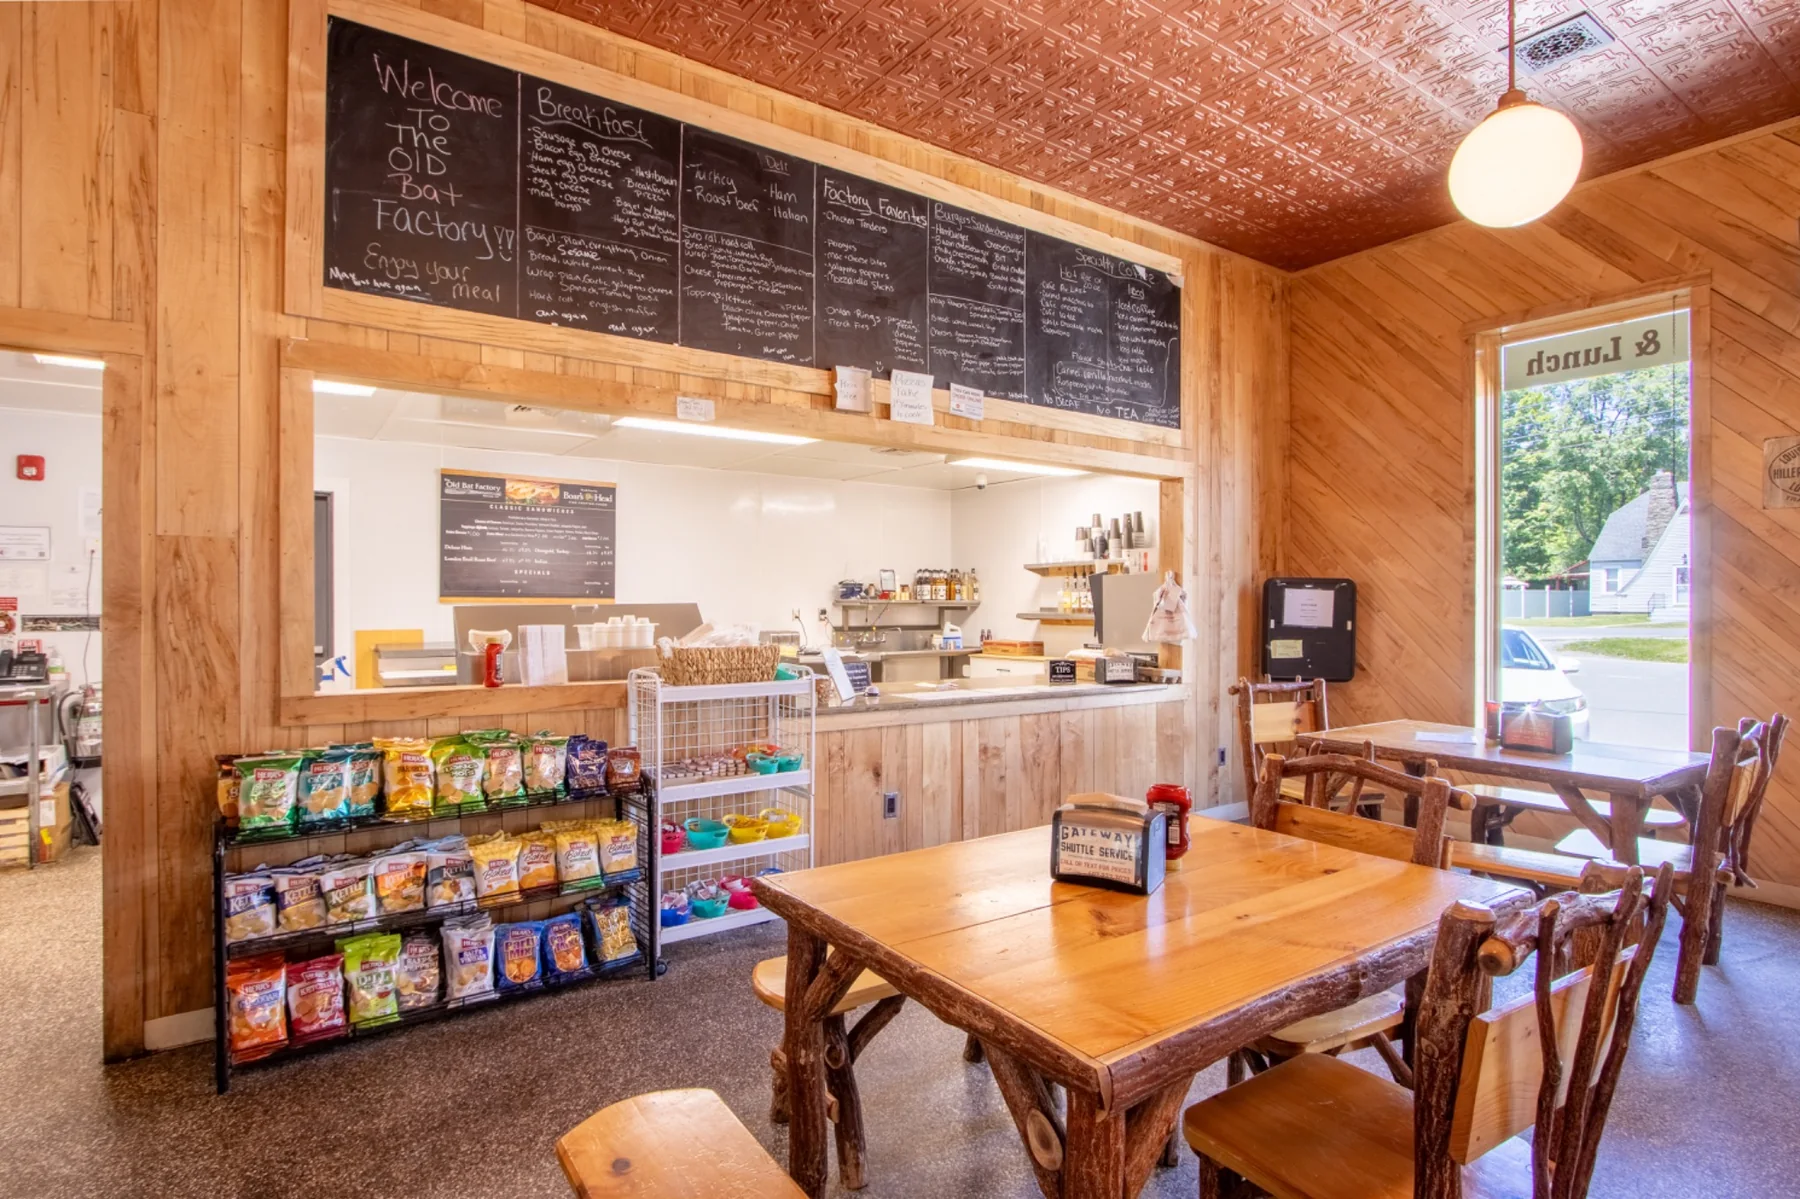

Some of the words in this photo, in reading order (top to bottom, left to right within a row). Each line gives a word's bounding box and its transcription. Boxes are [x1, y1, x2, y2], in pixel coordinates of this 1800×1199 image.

[373, 53, 502, 118] Welcome
[537, 86, 649, 142] Breakfast
[384, 122, 451, 156] The
[532, 126, 576, 151] Sausage
[534, 138, 566, 155] Bacon
[530, 150, 554, 164] Ham
[764, 154, 790, 172] Deli
[387, 172, 463, 207] Bat
[693, 185, 731, 207] Roast
[769, 182, 798, 204] Ham
[823, 177, 873, 217] Factory
[878, 197, 928, 227] Favorites
[363, 242, 420, 281] Enjoy
[426, 261, 471, 285] your
[452, 283, 500, 303] meal
[1115, 406, 1140, 421] TEA
[445, 481, 460, 489] Old
[461, 482, 474, 490] Bat
[474, 483, 502, 493] Factory
[1054, 666, 1071, 674] TIPS
[1061, 825, 1133, 849] GATEWAY
[1060, 841, 1095, 856] SHUTTLE
[1098, 846, 1133, 861] SERVICE
[283, 883, 319, 905] KETTLE
